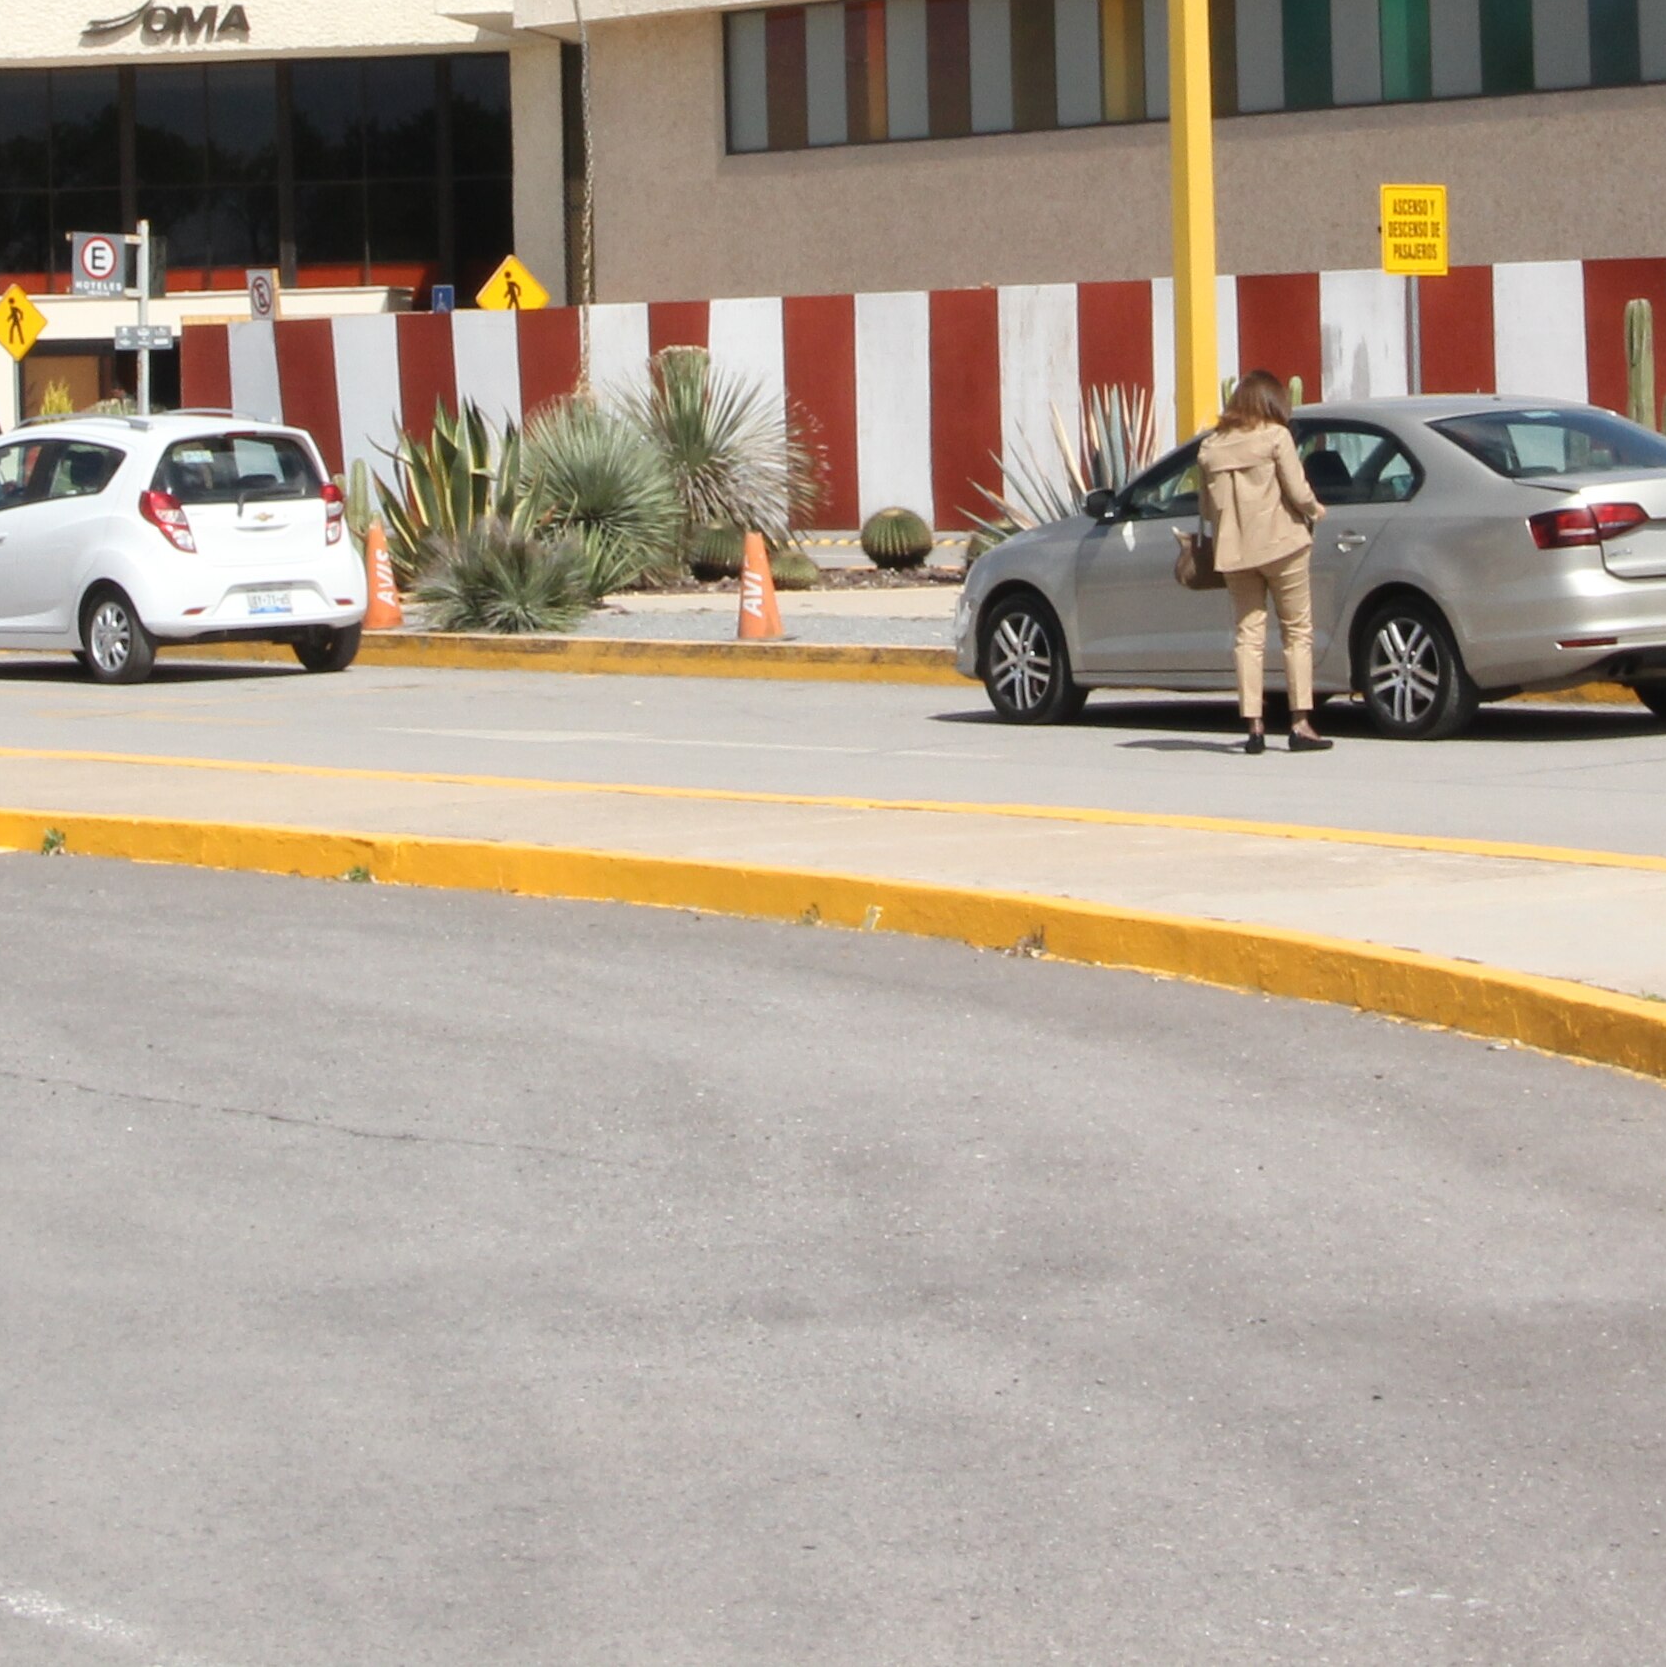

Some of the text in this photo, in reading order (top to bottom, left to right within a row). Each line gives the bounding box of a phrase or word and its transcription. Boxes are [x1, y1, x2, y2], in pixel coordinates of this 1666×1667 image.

[142, 4, 251, 34] OMA
[1393, 198, 1435, 216] ASCENSO Y
[1388, 220, 1441, 239] DESCENSO DE
[91, 246, 106, 270] E
[1393, 243, 1437, 260] PASAJEROS
[75, 280, 123, 292] HOTELES
[375, 548, 396, 607] AVIS
[743, 554, 764, 619] AVI
